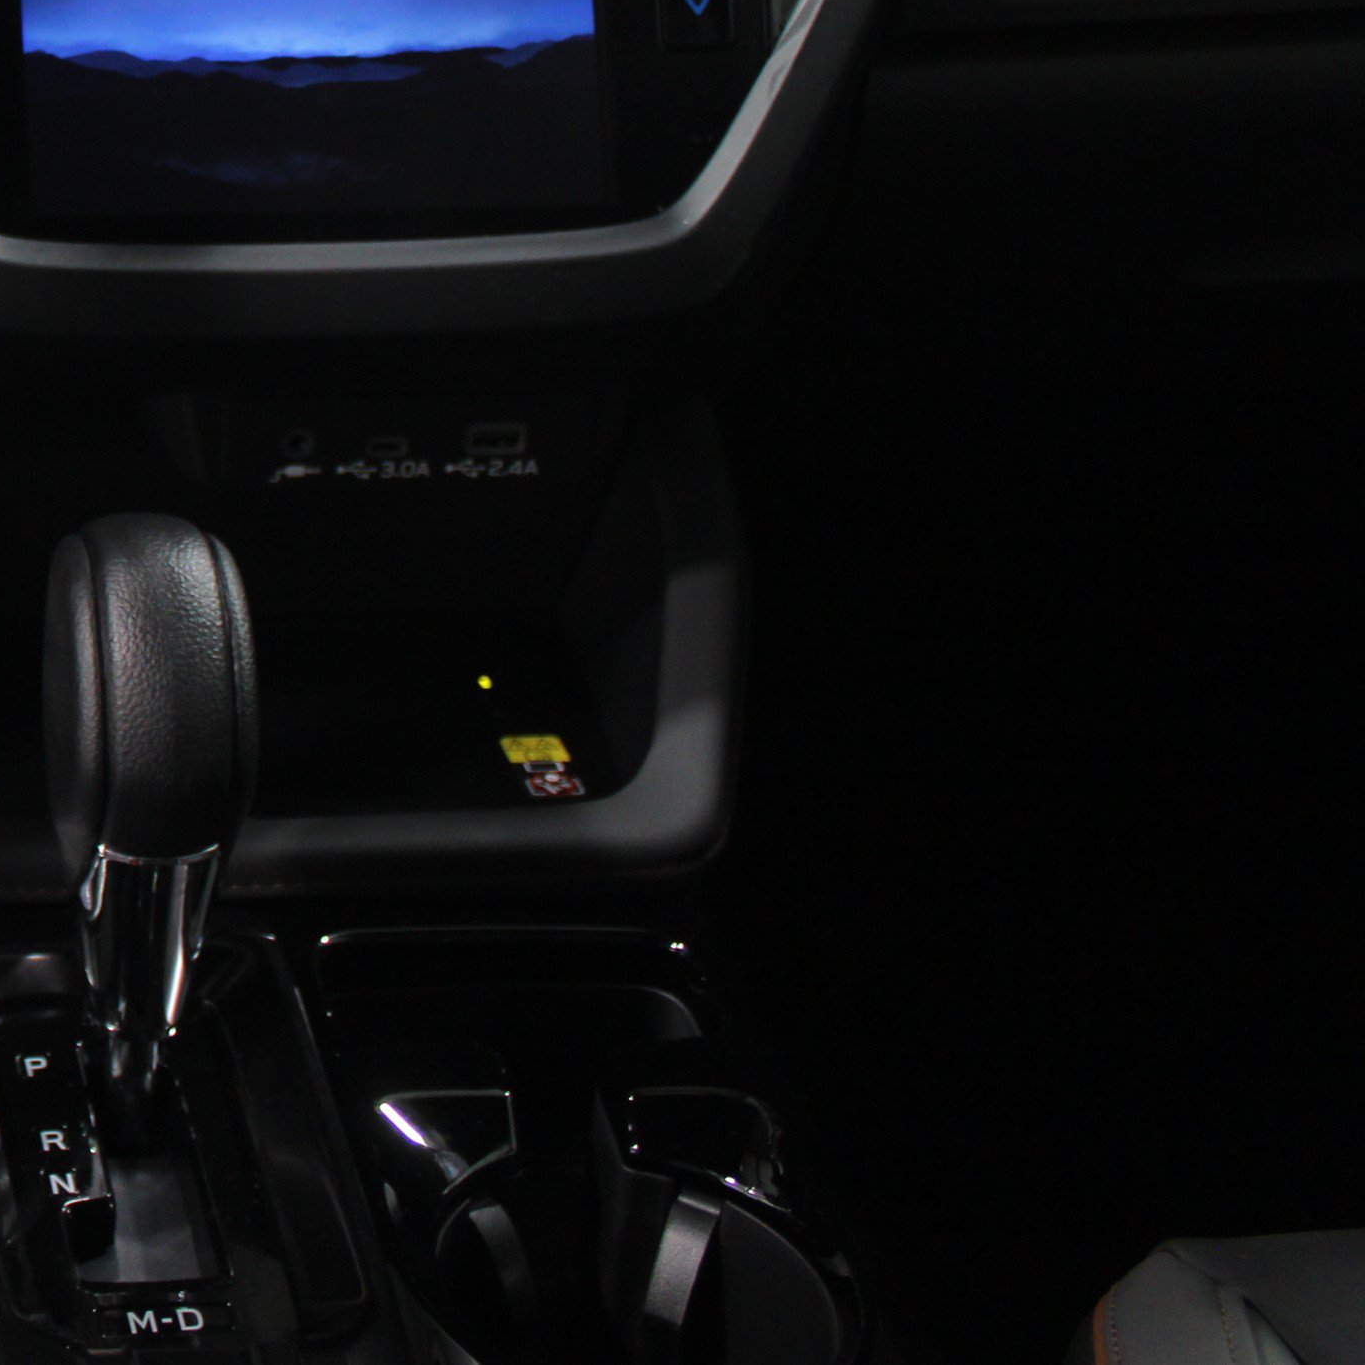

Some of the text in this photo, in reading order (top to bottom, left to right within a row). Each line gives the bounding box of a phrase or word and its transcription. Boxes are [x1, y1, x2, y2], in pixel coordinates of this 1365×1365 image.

[379, 459, 539, 478] 3.0A 2.4A
[24, 1056, 48, 1078] P
[40, 1130, 69, 1152] R
[48, 1172, 79, 1195] N
[126, 1307, 205, 1335] M-D
